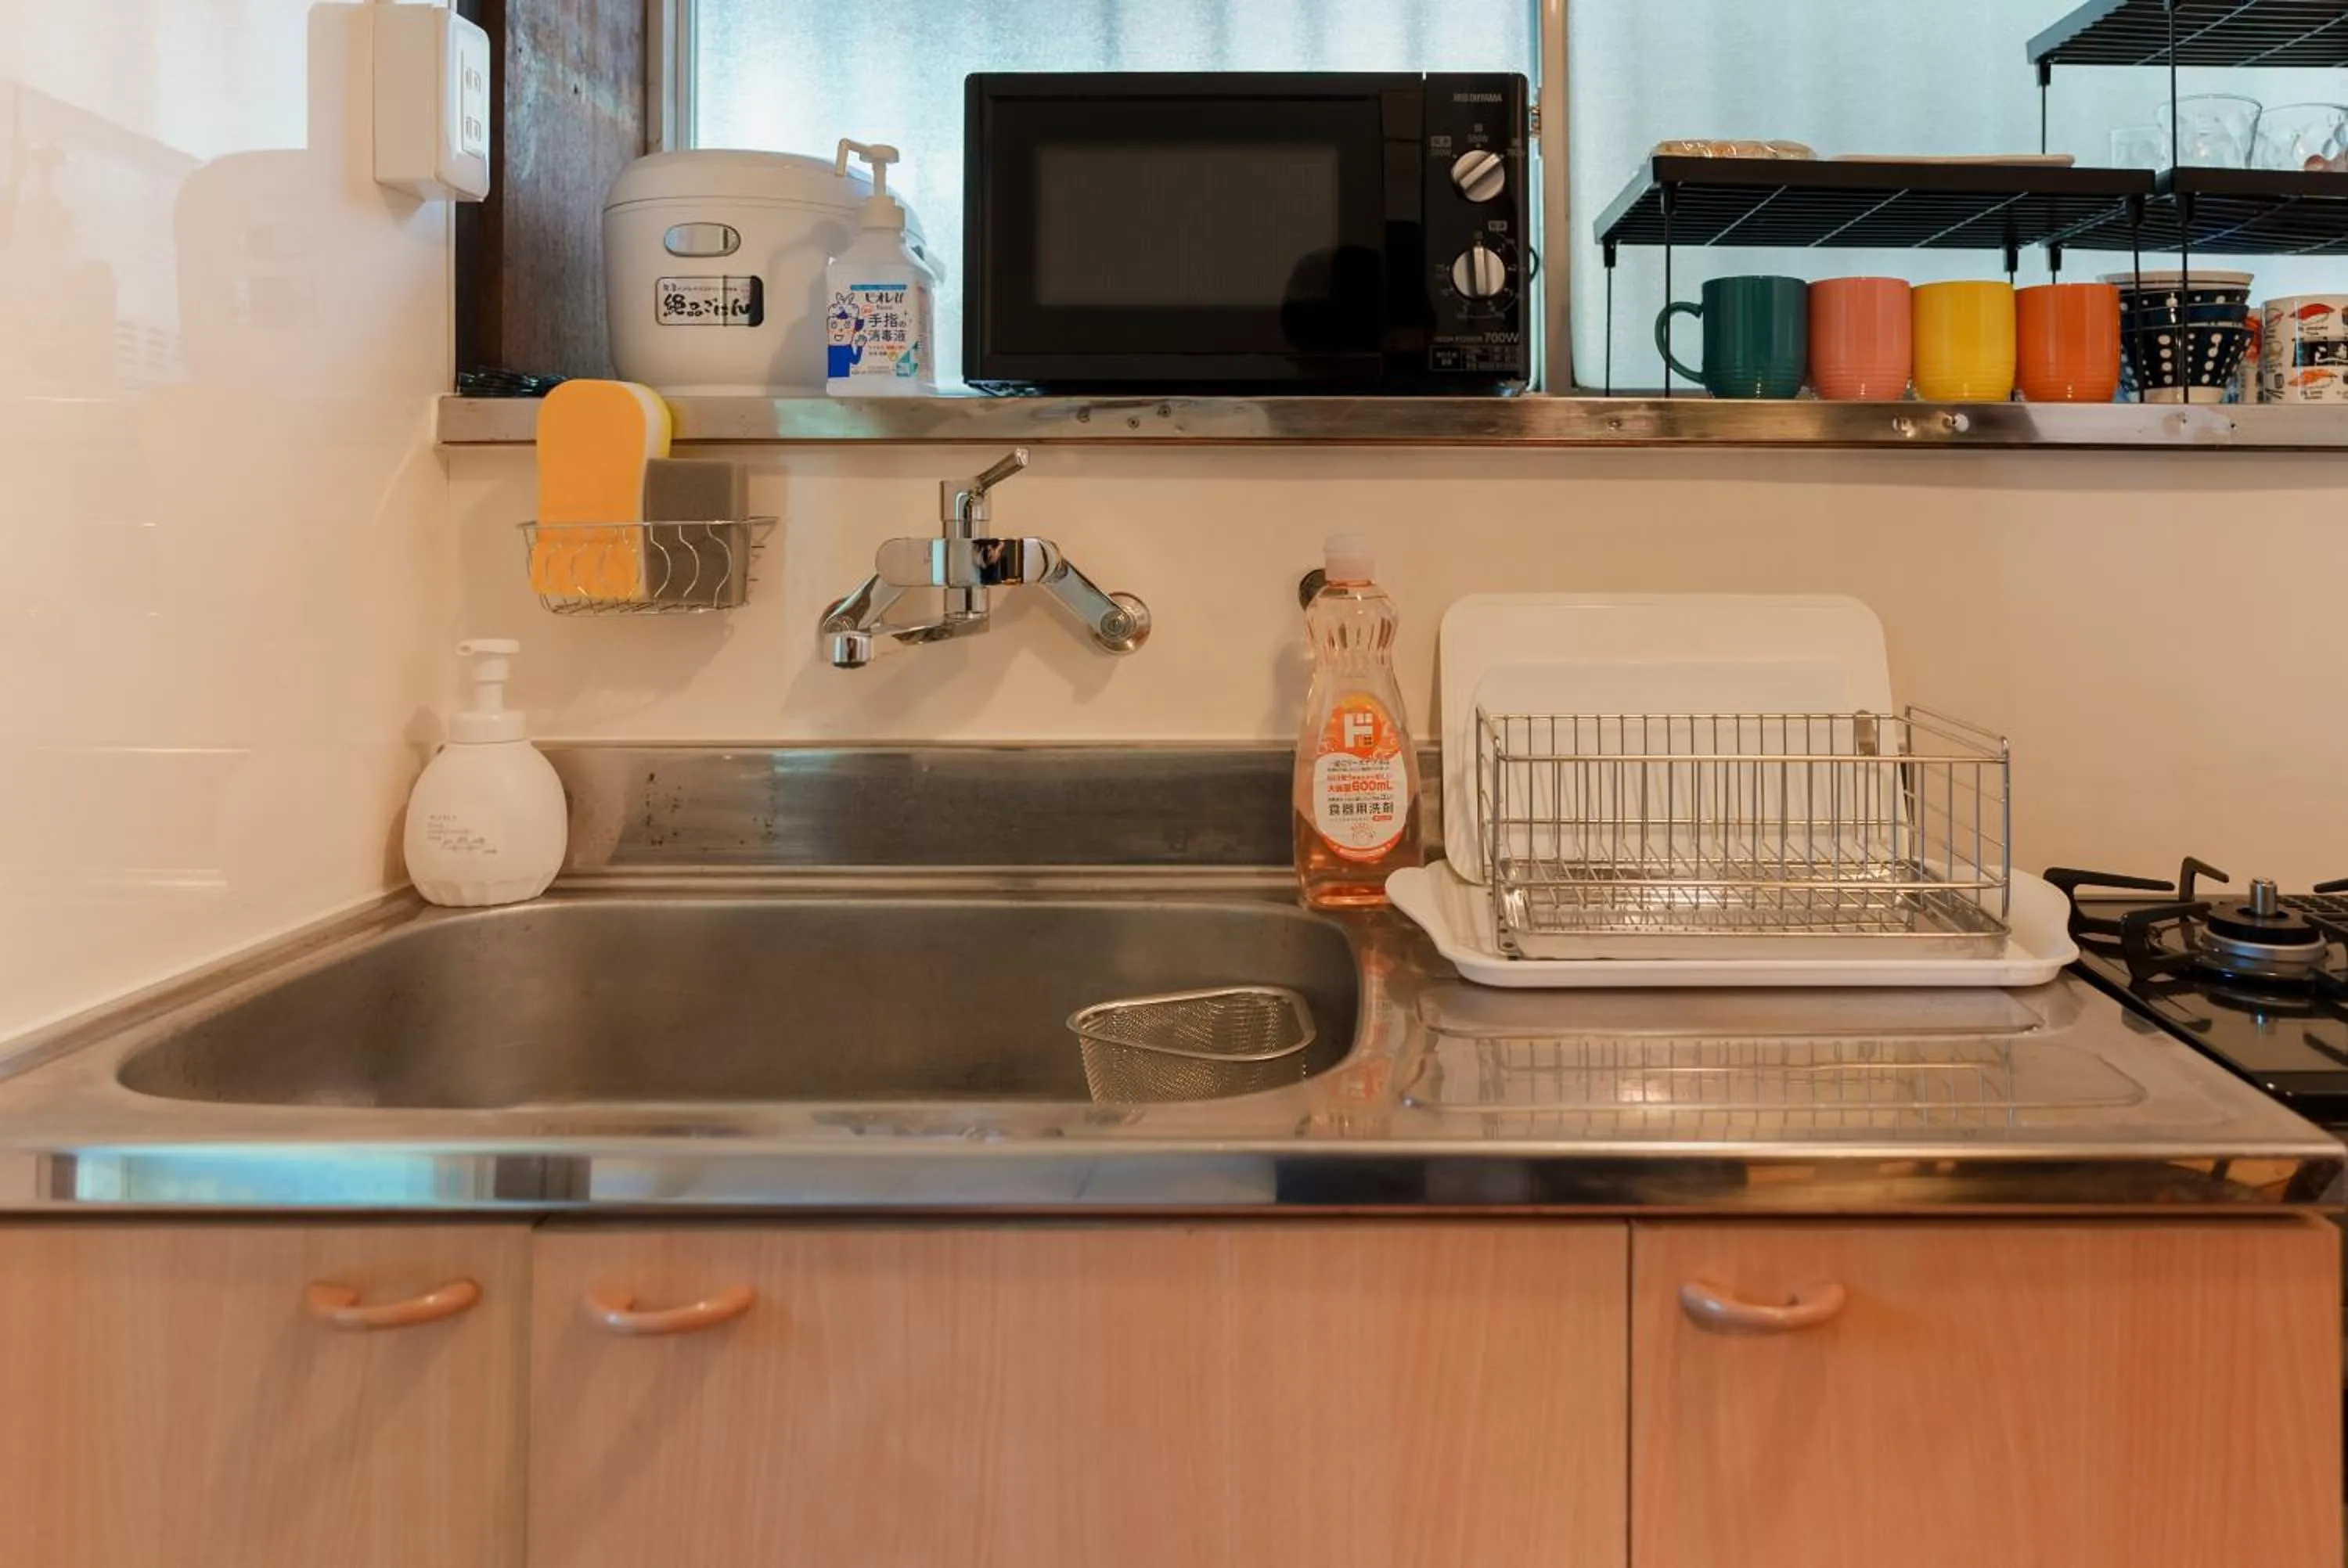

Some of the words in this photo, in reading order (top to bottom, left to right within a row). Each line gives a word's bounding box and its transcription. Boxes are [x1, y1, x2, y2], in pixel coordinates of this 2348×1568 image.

[663, 294, 750, 316] 絶品ごはん
[868, 312, 906, 328] 手指の
[868, 329, 906, 342] 消毒液
[1483, 332, 1519, 343] 700W
[1328, 801, 1394, 815] 食器用洗剤
